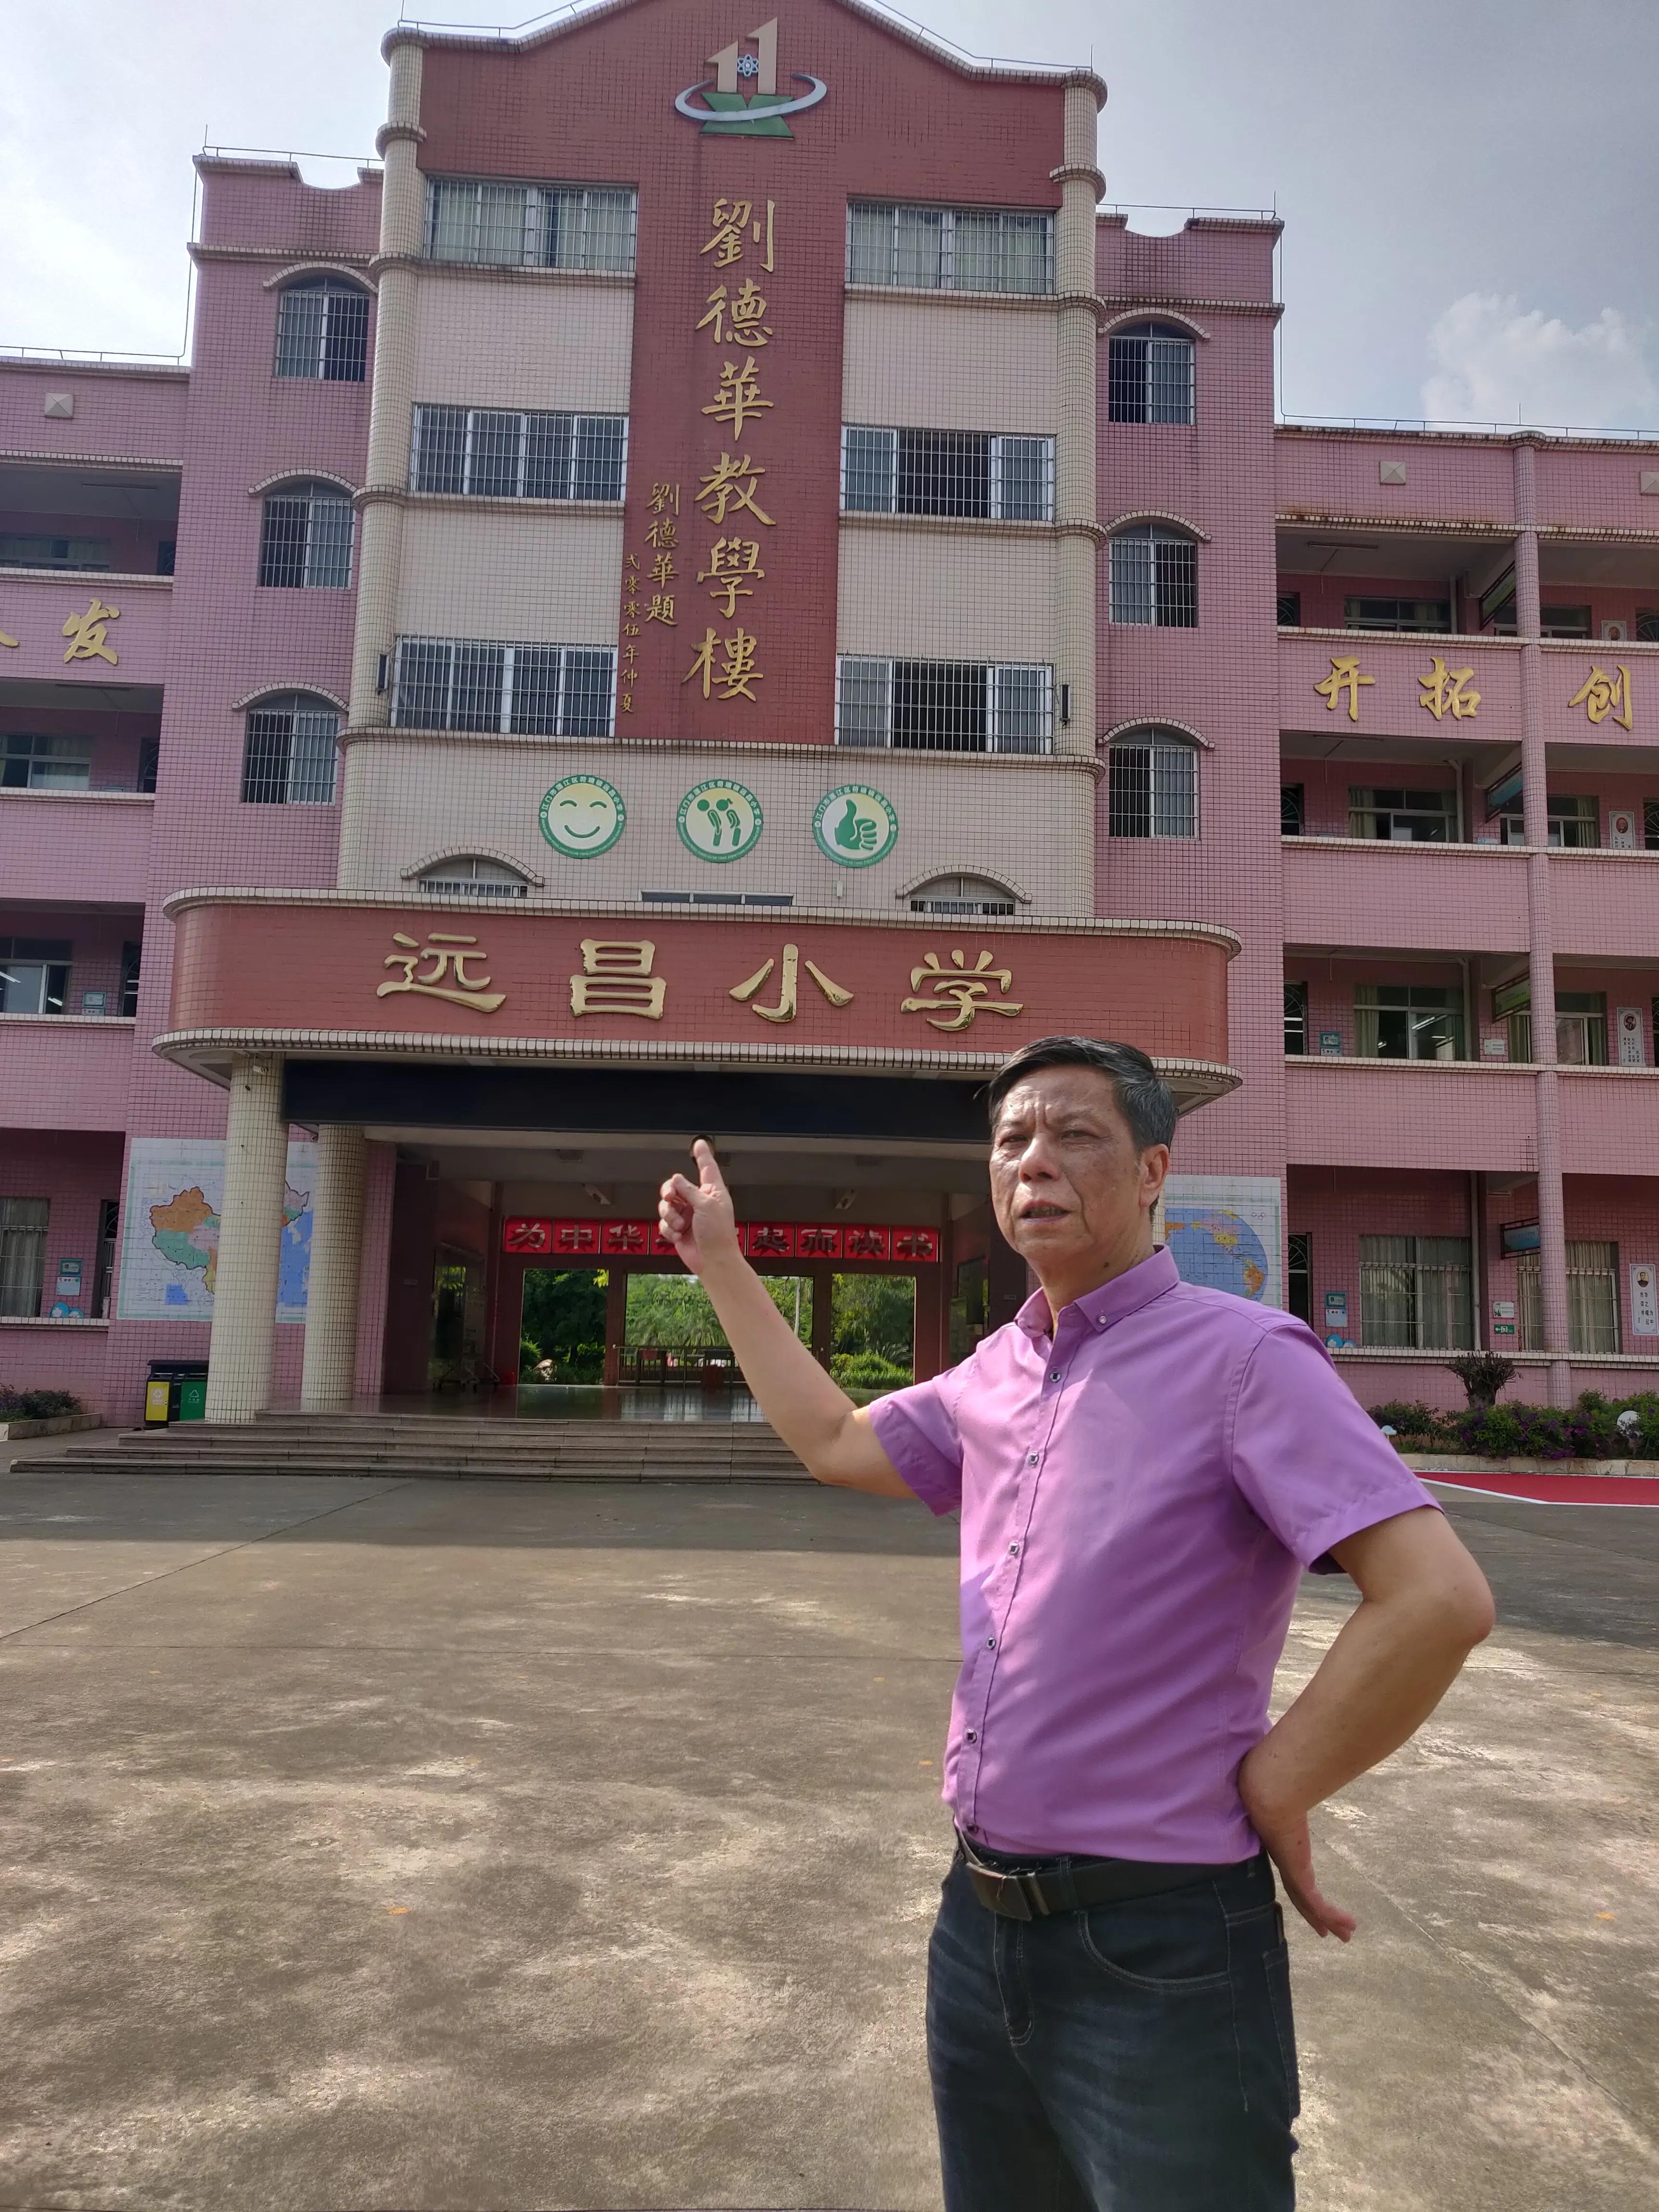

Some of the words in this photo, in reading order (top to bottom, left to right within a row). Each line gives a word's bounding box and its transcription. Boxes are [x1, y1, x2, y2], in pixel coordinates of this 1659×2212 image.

[645, 482, 680, 625] 劉德華題
[377, 932, 1024, 1032] 远昌小学
[509, 1223, 933, 1257] 为中华起而读书
